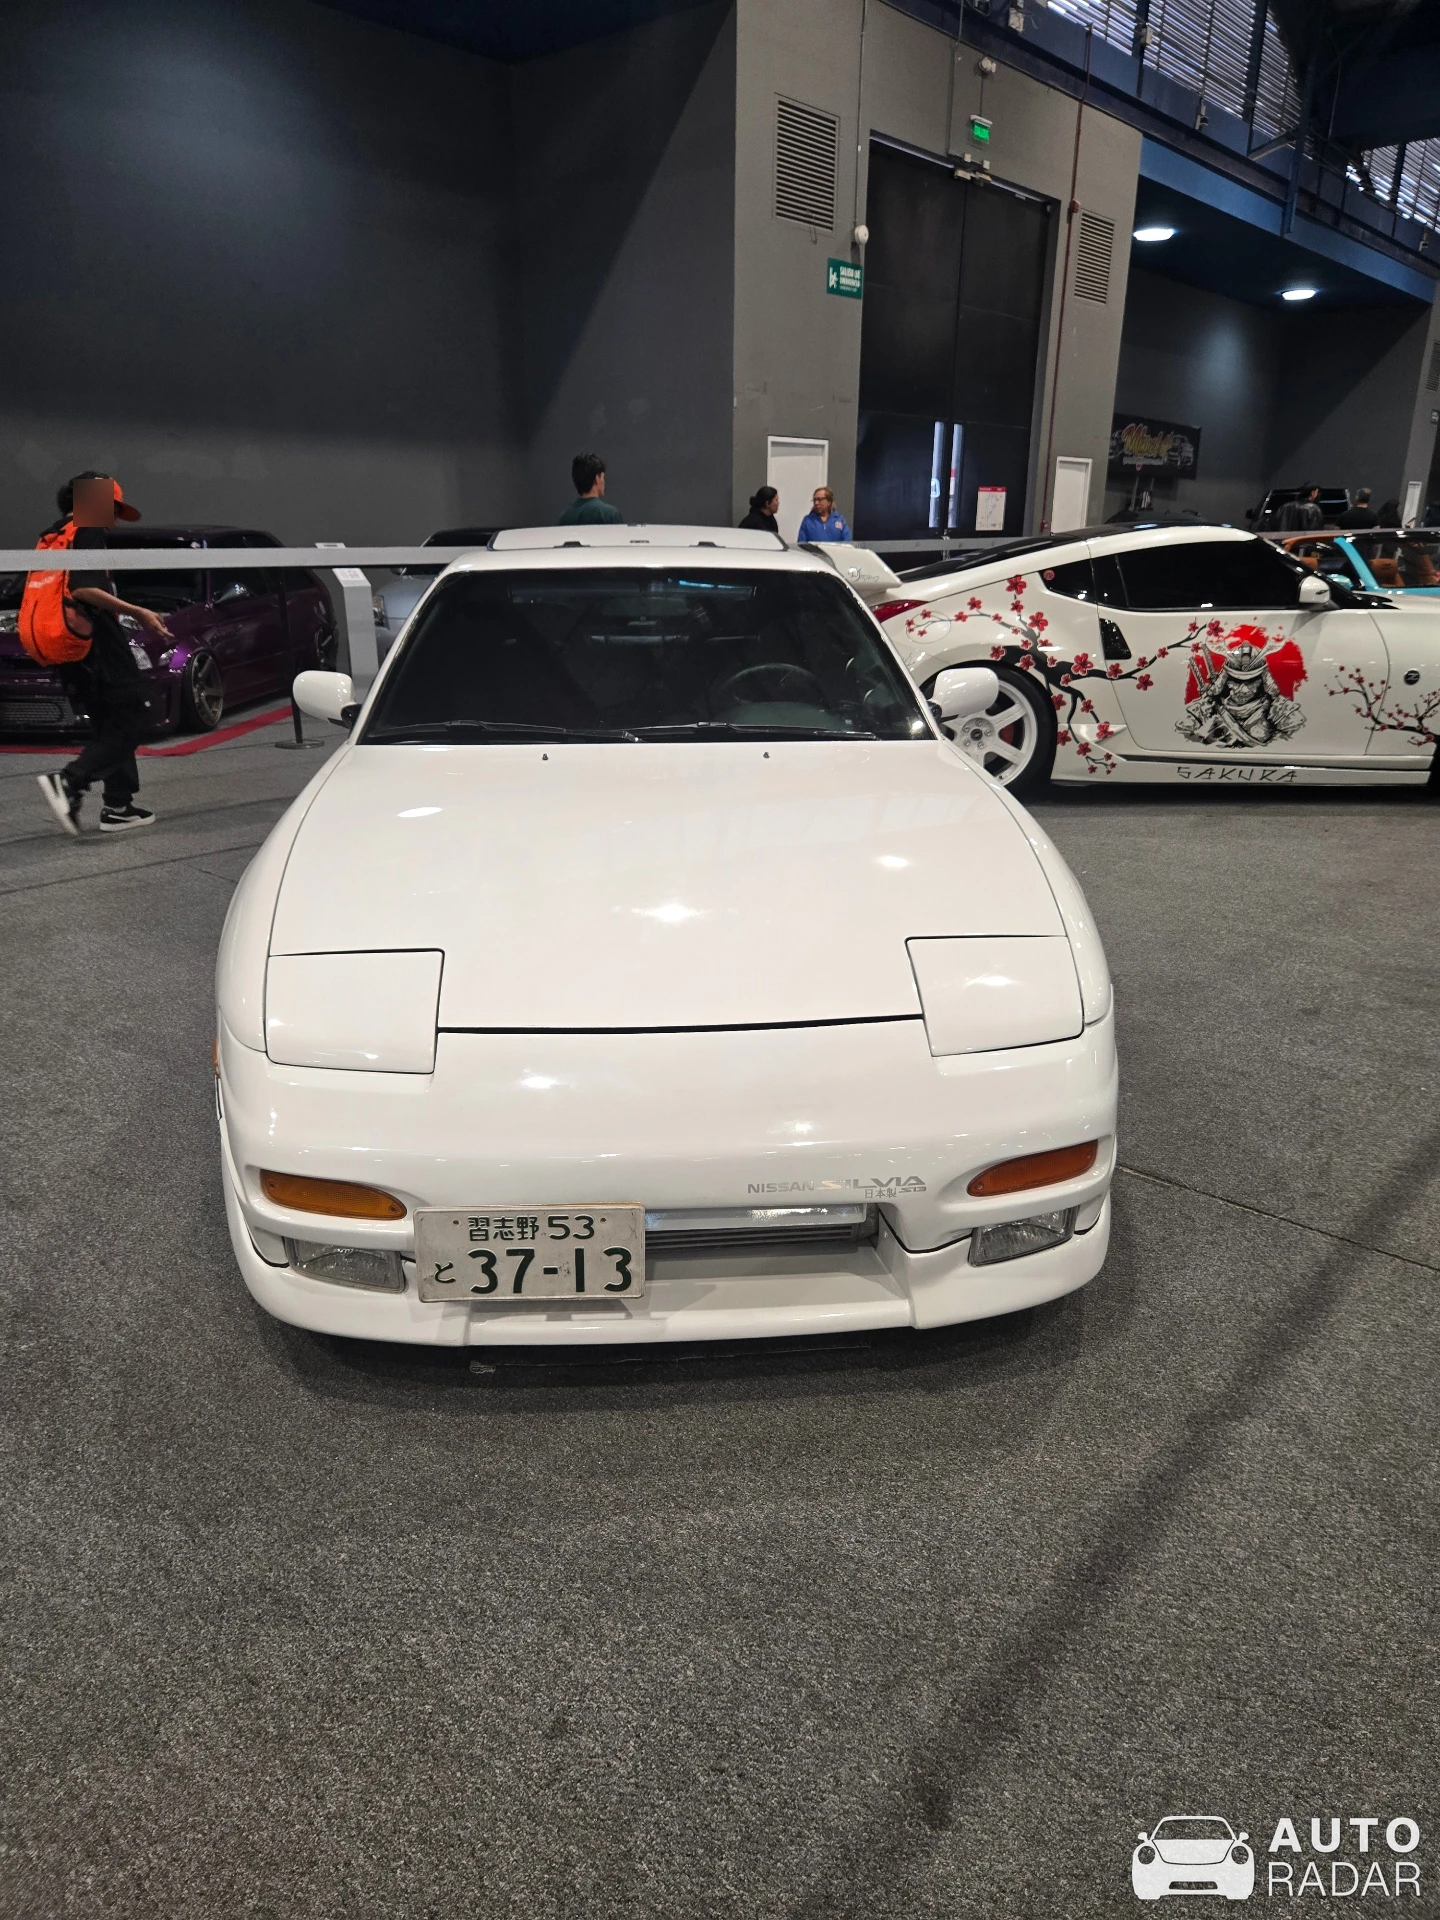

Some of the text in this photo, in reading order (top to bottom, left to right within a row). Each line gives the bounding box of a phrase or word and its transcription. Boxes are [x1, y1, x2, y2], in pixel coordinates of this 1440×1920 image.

[1176, 766, 1298, 783] SAKURA
[747, 1181, 815, 1194] NISSAN
[467, 1214, 595, 1241] 習志野 53
[434, 1246, 632, 1294] と 37-13
